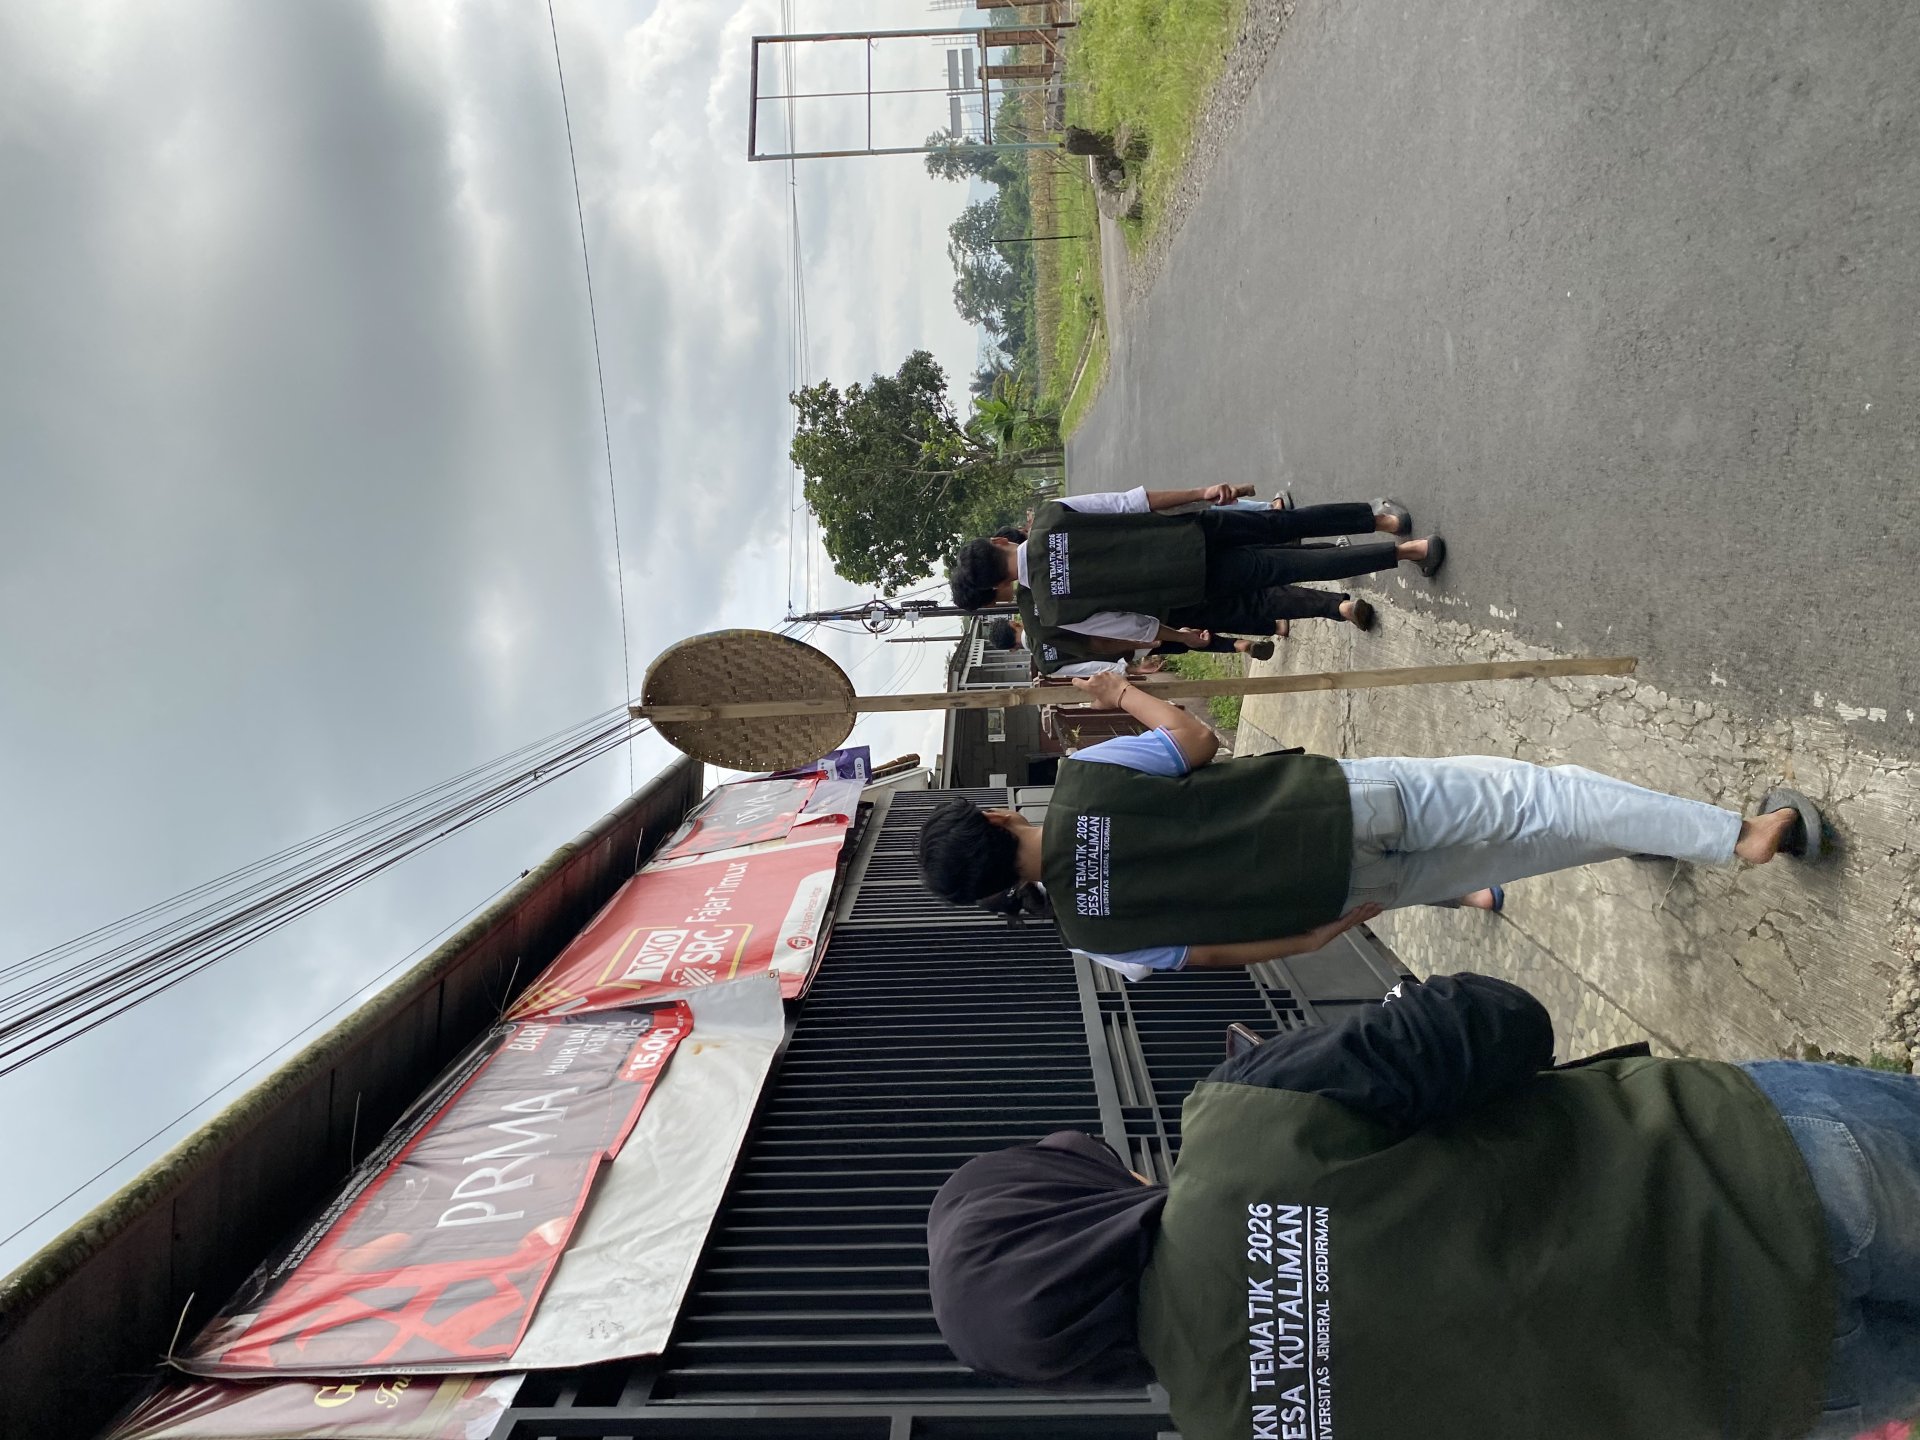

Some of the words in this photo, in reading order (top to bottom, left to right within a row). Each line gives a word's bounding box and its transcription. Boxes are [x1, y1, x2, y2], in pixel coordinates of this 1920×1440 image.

[1048, 533, 1056, 549] 2026
[1055, 533, 1063, 573] KUTALIMAN
[1049, 551, 1057, 579] TEMATIK
[1050, 581, 1058, 595] KKN
[1057, 575, 1065, 595] DESA
[1076, 815, 1088, 840] 2026
[1075, 844, 1087, 888] TEMATIK
[1087, 816, 1100, 880] KUTALIMAN
[703, 862, 749, 897] Timur
[684, 896, 733, 923] Fajar
[1077, 893, 1088, 916] KKN
[1088, 886, 1100, 916] DESA
[627, 932, 683, 975] TOKO
[679, 928, 734, 965] SRC
[541, 1047, 580, 1076] HADIR
[1247, 1203, 1273, 1265] 2026
[1314, 1206, 1331, 1293] SOEDIRMAN
[1276, 1203, 1305, 1370] KUTALIMAN
[1248, 1276, 1276, 1392] TEMATIK
[1316, 1299, 1331, 1361] JENDERAL
[1251, 1404, 1279, 1440] KN
[1280, 1384, 1307, 1440] ESA
